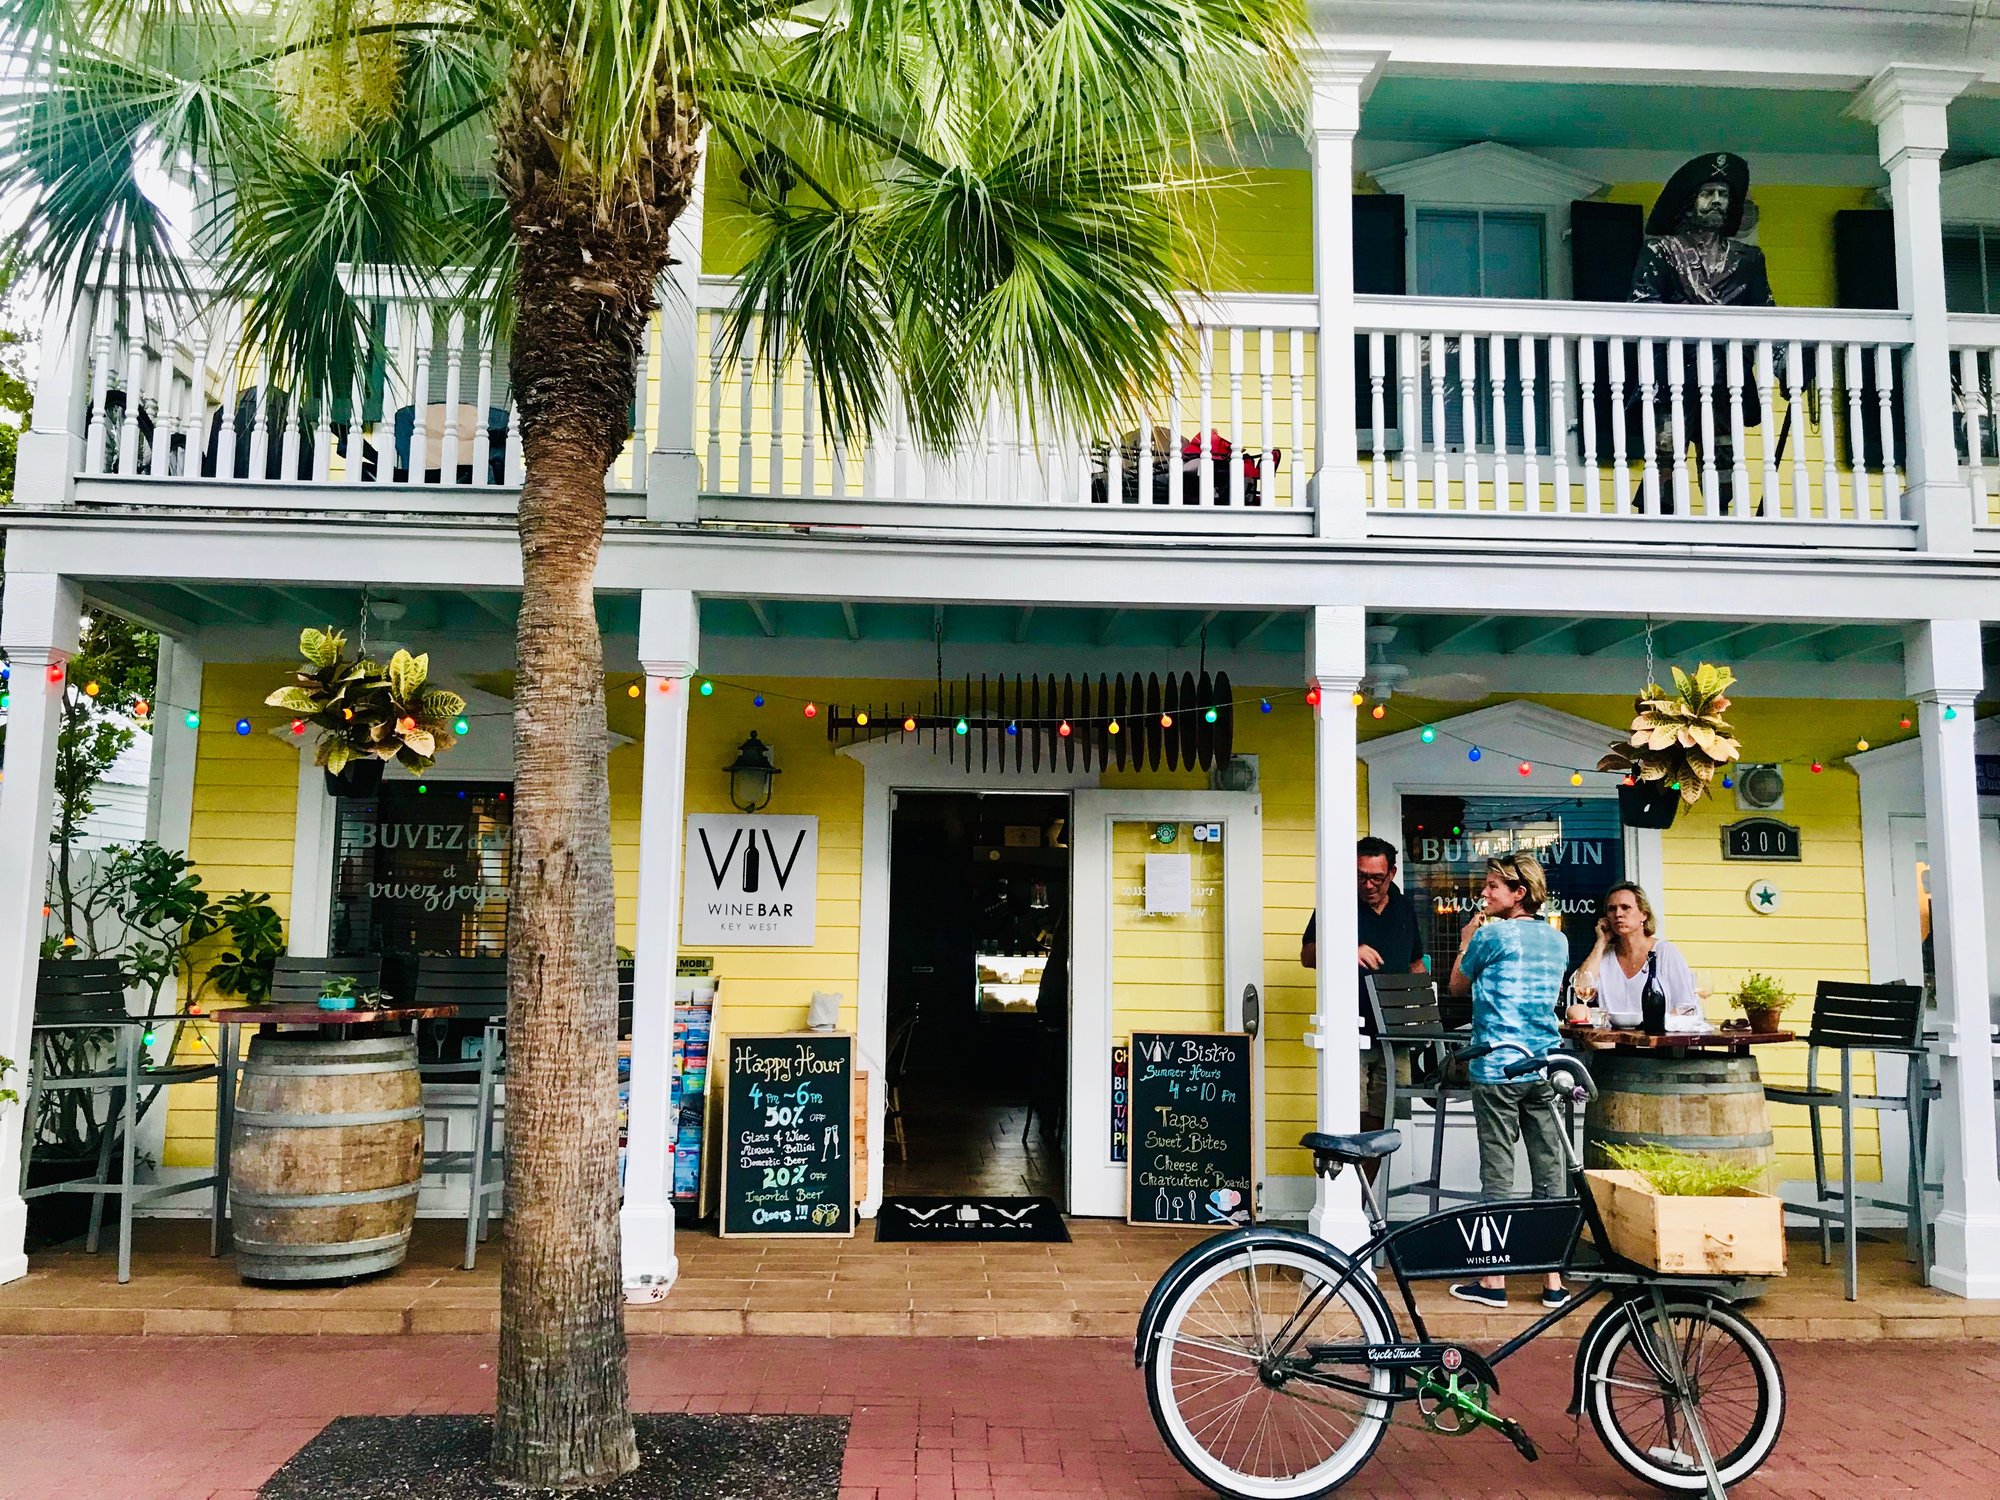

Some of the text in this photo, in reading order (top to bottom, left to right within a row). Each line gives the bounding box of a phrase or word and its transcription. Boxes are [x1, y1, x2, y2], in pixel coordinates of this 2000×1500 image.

[360, 823, 464, 849] BUVEZ
[1741, 831, 1786, 852] 300
[698, 828, 807, 893] VIV
[1551, 841, 1603, 865] VIN
[443, 864, 457, 878] et
[708, 903, 793, 917] WINEBAR
[721, 923, 778, 931] KEY WEST
[1138, 1034, 1236, 1064] VIV Bistro
[735, 1044, 845, 1082] Happy Hour
[1140, 1063, 1221, 1082] Summer Hours
[748, 1082, 763, 1110] 4
[1169, 1079, 1180, 1100] 4
[1200, 1082, 1217, 1102] 10
[764, 1105, 806, 1128] 50%
[1154, 1106, 1209, 1133] Tapas
[741, 1129, 811, 1147] Glass of Wine
[1144, 1130, 1228, 1153] Sweet Bites
[740, 1156, 809, 1168] Domestic Beer
[1154, 1154, 1214, 1174] Cheese &
[762, 1165, 809, 1189] 20%
[1139, 1170, 1250, 1190] Charcuterie Boards
[745, 1188, 825, 1206] Imported Beer
[752, 1207, 792, 1225] Cheers
[894, 1203, 1041, 1221] VIV
[1456, 1214, 1512, 1252] VIV
[1466, 1255, 1511, 1265] WINEBAR
[1367, 1347, 1421, 1360] Cycle Truck
